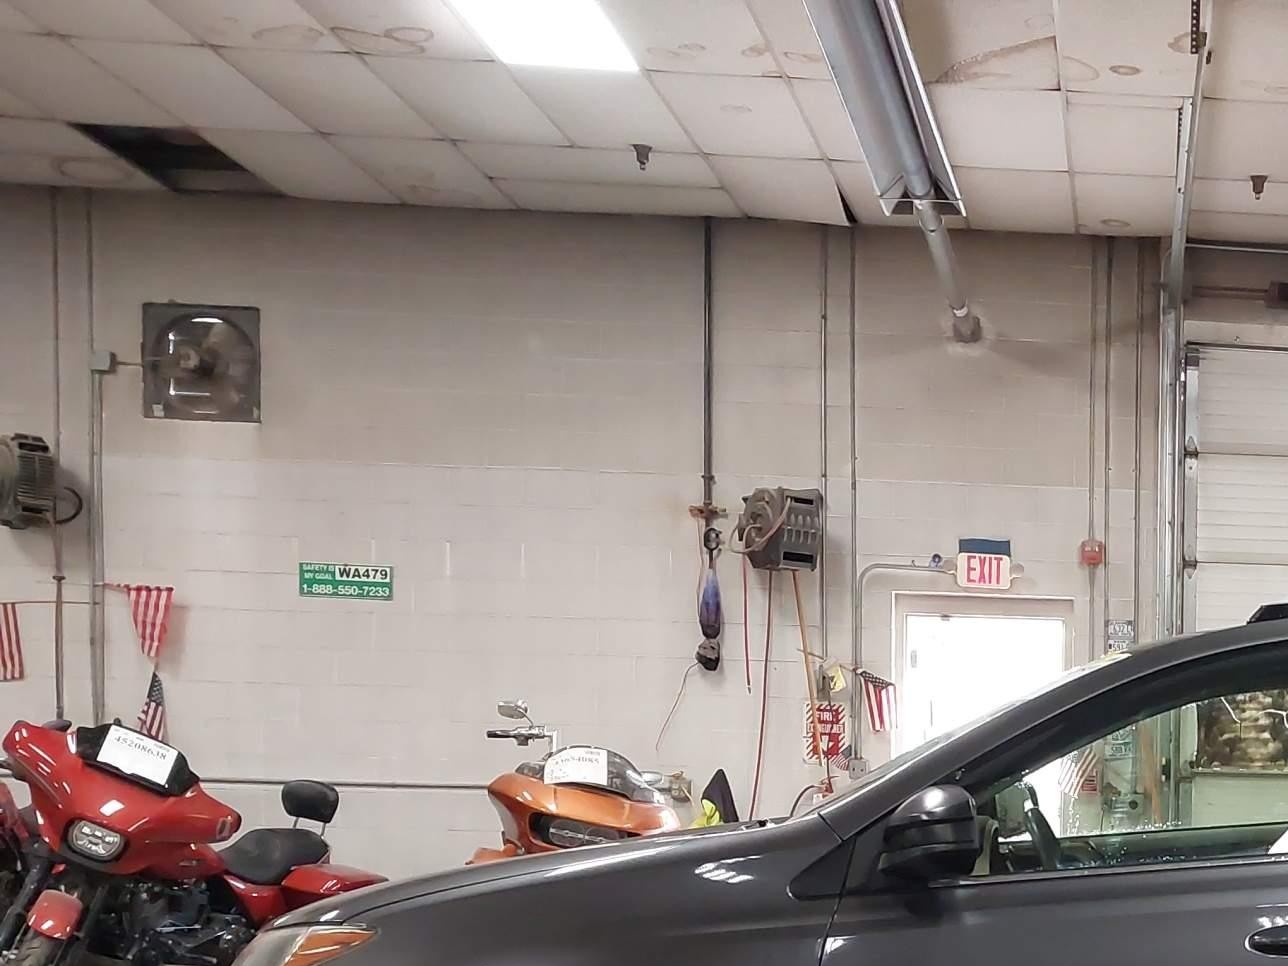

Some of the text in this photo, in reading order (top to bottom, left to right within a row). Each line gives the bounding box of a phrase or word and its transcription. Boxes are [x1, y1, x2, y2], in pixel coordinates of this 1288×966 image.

[302, 563, 328, 571] SAFETY
[337, 566, 389, 581] WA479
[966, 555, 1003, 585] EXIT
[302, 583, 390, 597] 1-888-550-7233
